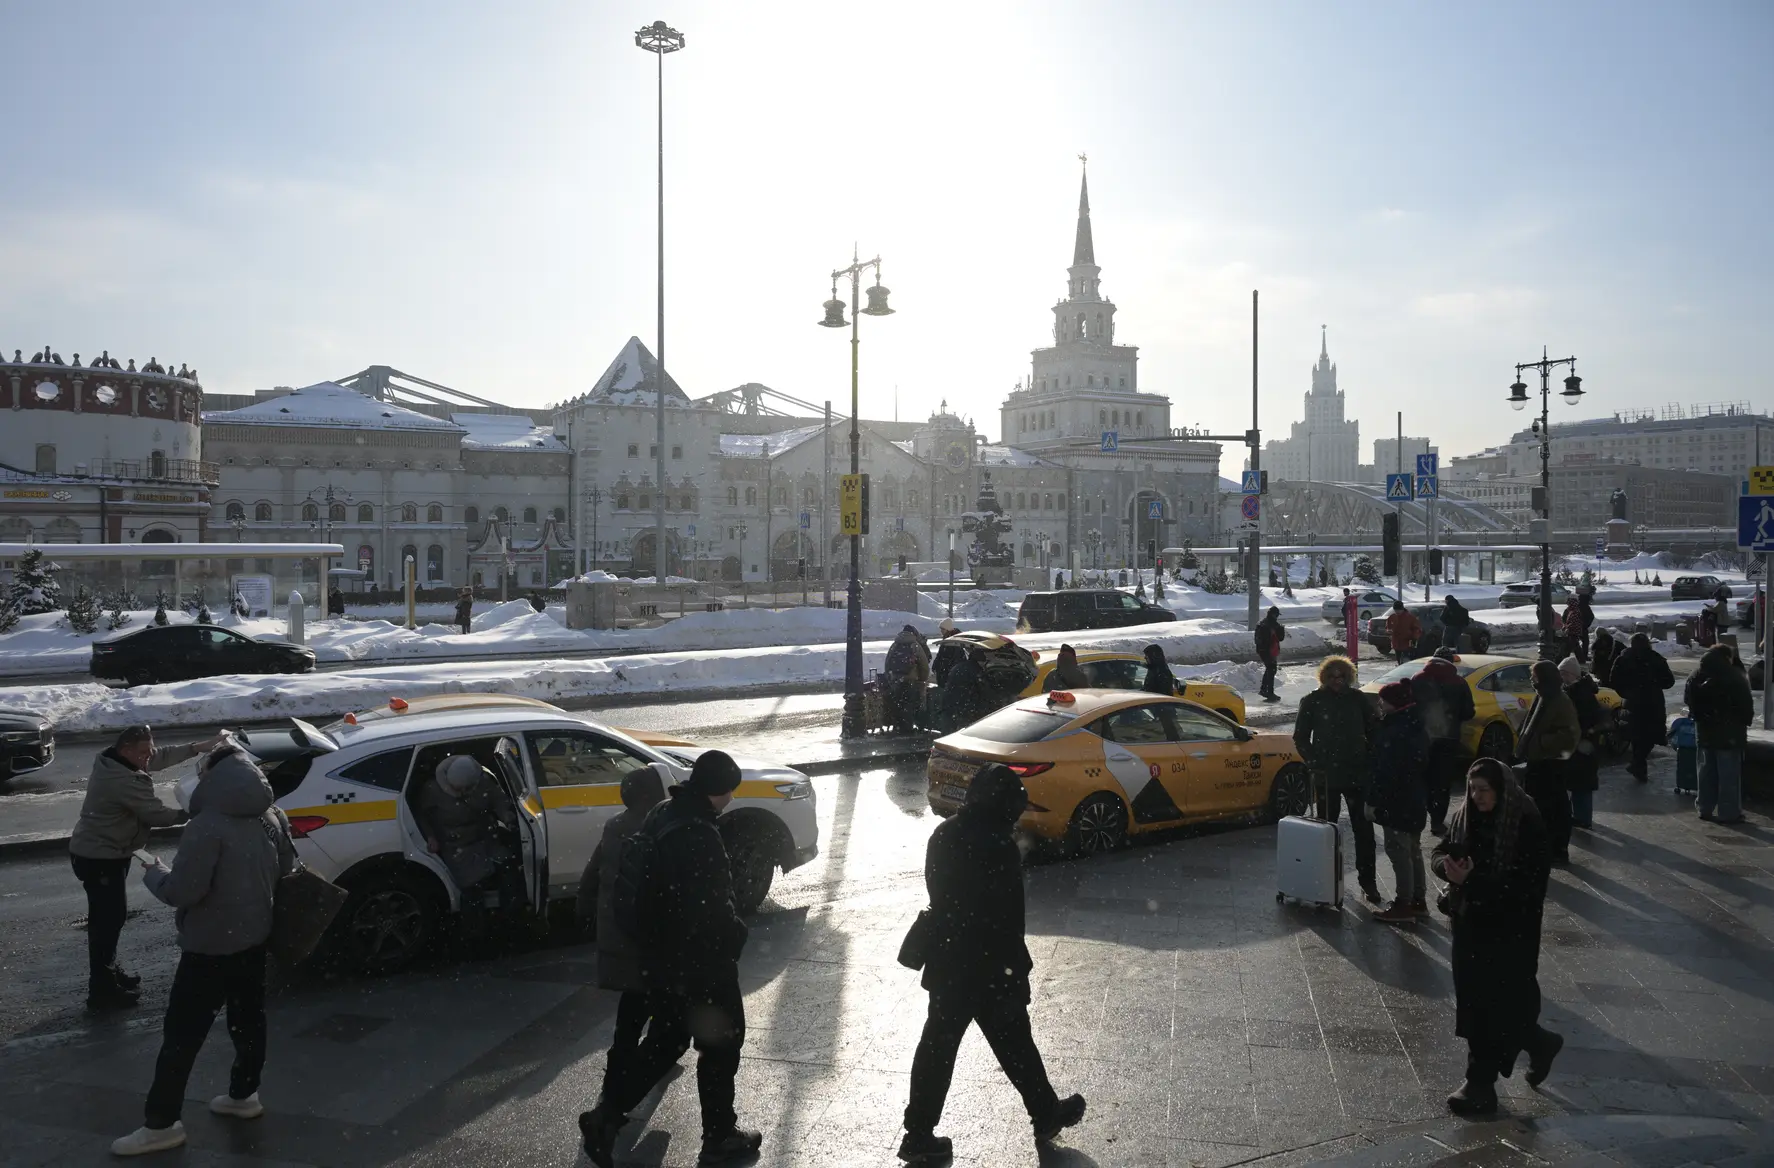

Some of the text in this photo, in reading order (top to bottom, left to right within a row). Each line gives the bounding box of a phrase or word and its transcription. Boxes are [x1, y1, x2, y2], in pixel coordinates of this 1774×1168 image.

[1172, 763, 1186, 773] 034
[1224, 758, 1249, 769] Яндекс
[1243, 771, 1261, 780] Такси
